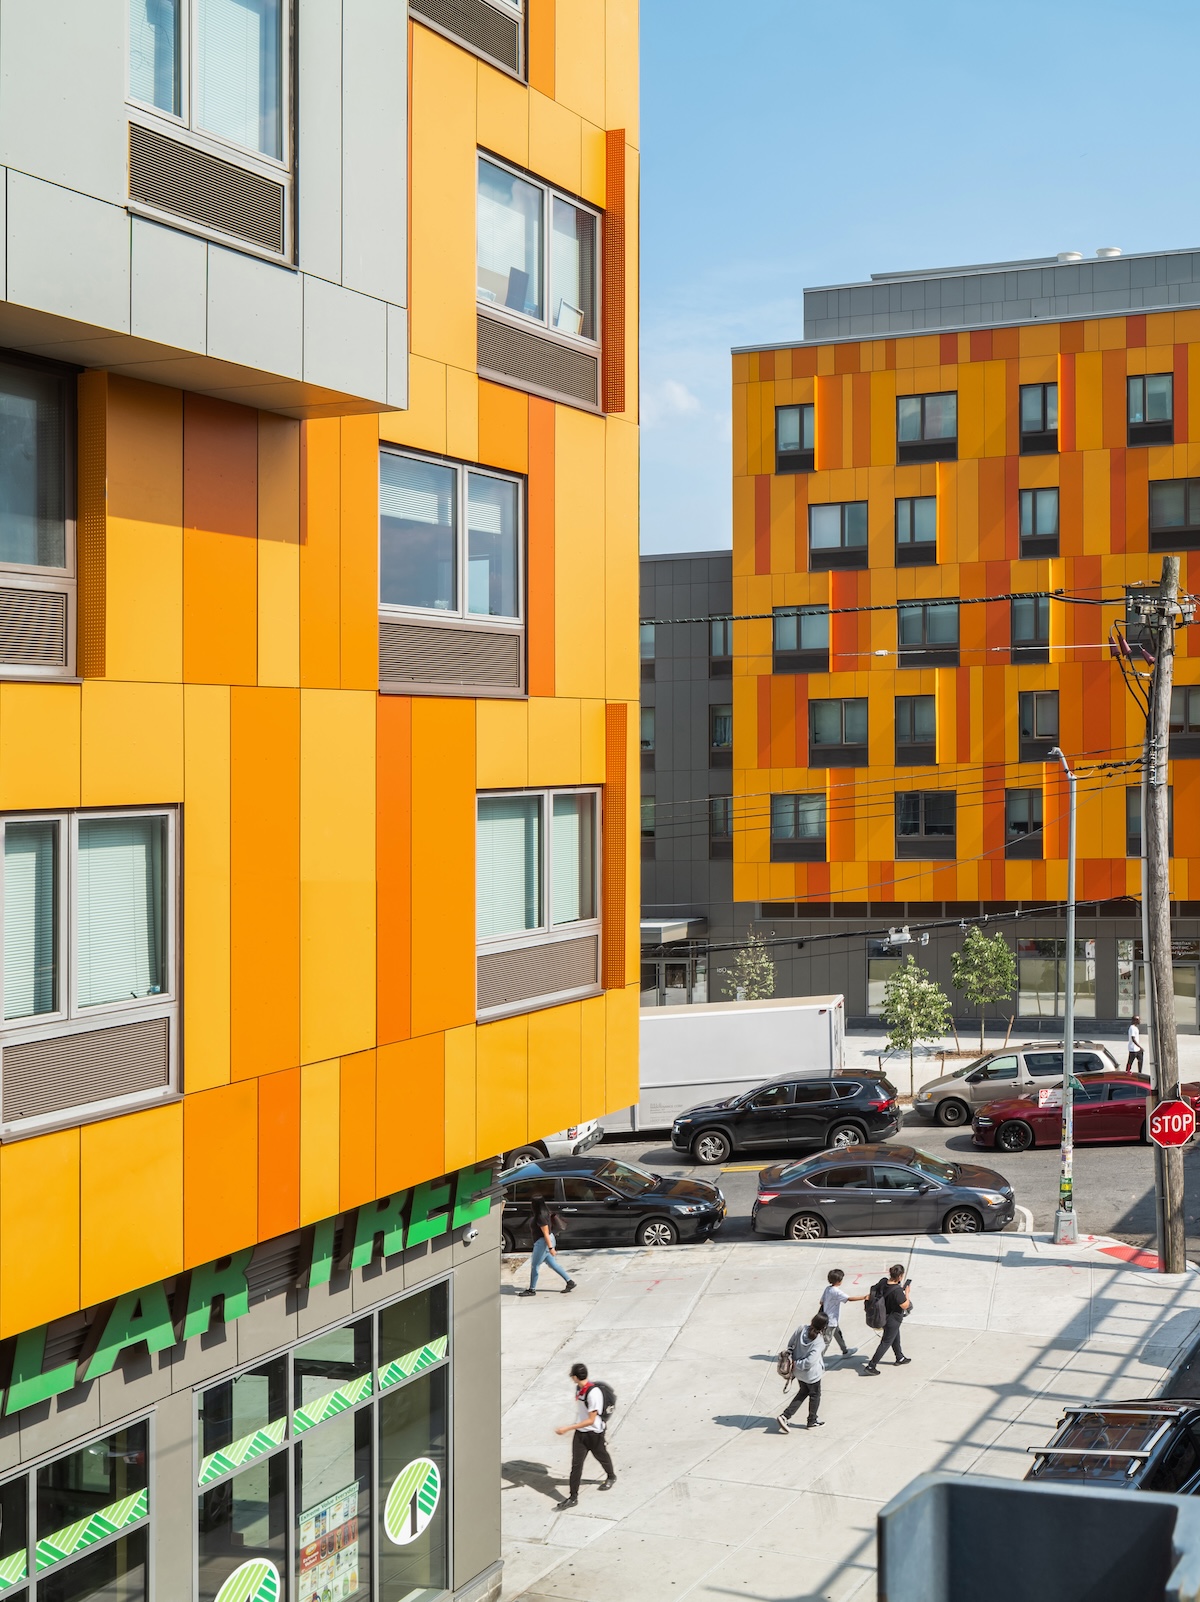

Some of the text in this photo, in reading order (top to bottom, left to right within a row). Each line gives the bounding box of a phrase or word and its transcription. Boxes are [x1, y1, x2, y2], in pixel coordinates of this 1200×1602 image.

[1151, 1113, 1193, 1134] STOP
[300, 1483, 358, 1521] Extreme Value Everyday!
